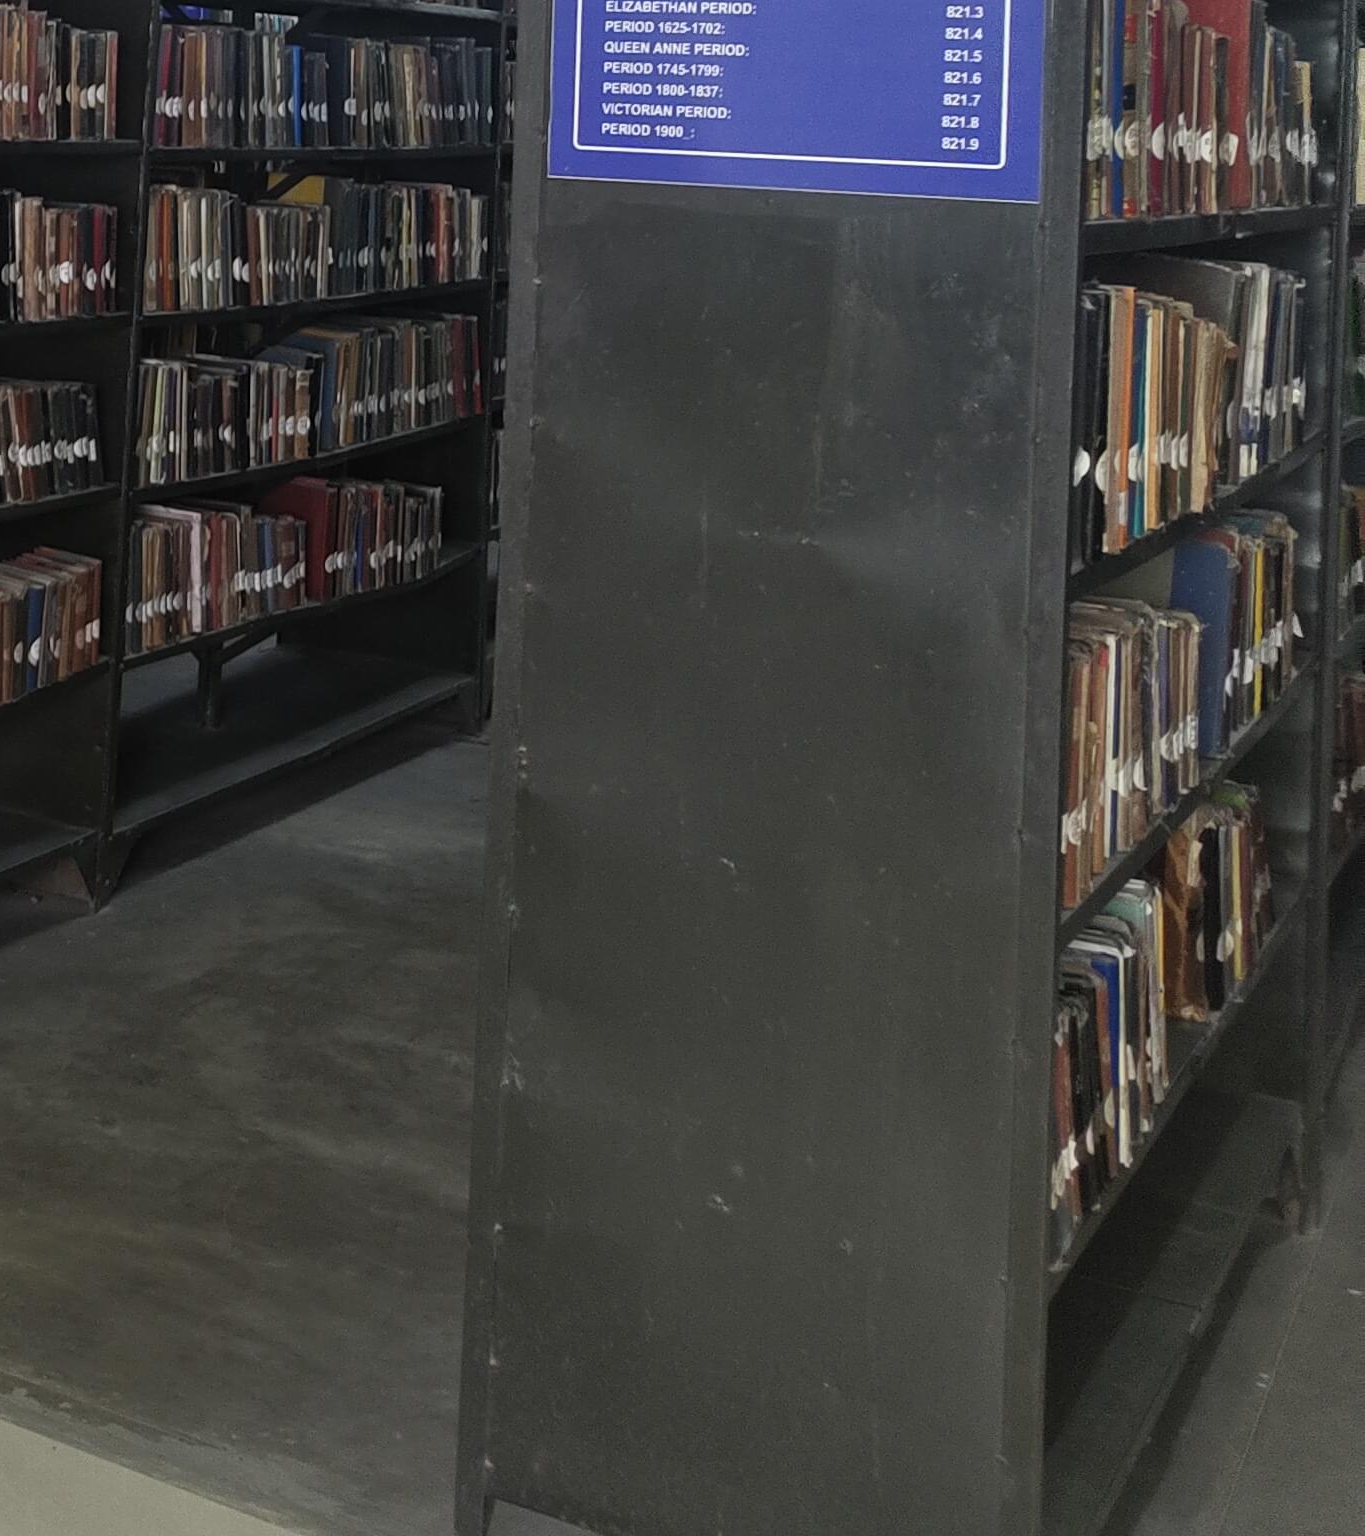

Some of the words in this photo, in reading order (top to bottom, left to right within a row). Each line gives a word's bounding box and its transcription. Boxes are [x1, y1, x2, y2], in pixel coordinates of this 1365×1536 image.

[605, 0, 697, 13] ELIZABETHAN
[700, 1, 756, 14] PERIOD:
[945, 5, 983, 18] 821.3
[604, 19, 654, 33] PERIOD
[657, 20, 725, 35] 1625-1702:
[944, 26, 983, 40] 821.4
[603, 40, 650, 53] QUEEN
[652, 41, 691, 55] ANNE
[693, 42, 749, 56] PERIOD:
[943, 48, 982, 62] 821.5
[603, 61, 653, 74] PERIOD
[656, 62, 723, 77] 1745-1799:
[943, 70, 982, 84] 821.6
[602, 81, 652, 95] PERIOD
[655, 83, 723, 98] 1800-1837:
[942, 92, 981, 106] 821.7
[601, 102, 673, 116] VICTORIAN
[675, 104, 731, 119] PERIOD:
[940, 114, 979, 128] 821.8
[601, 122, 651, 136] PERIOD
[941, 136, 979, 150] 821.9
